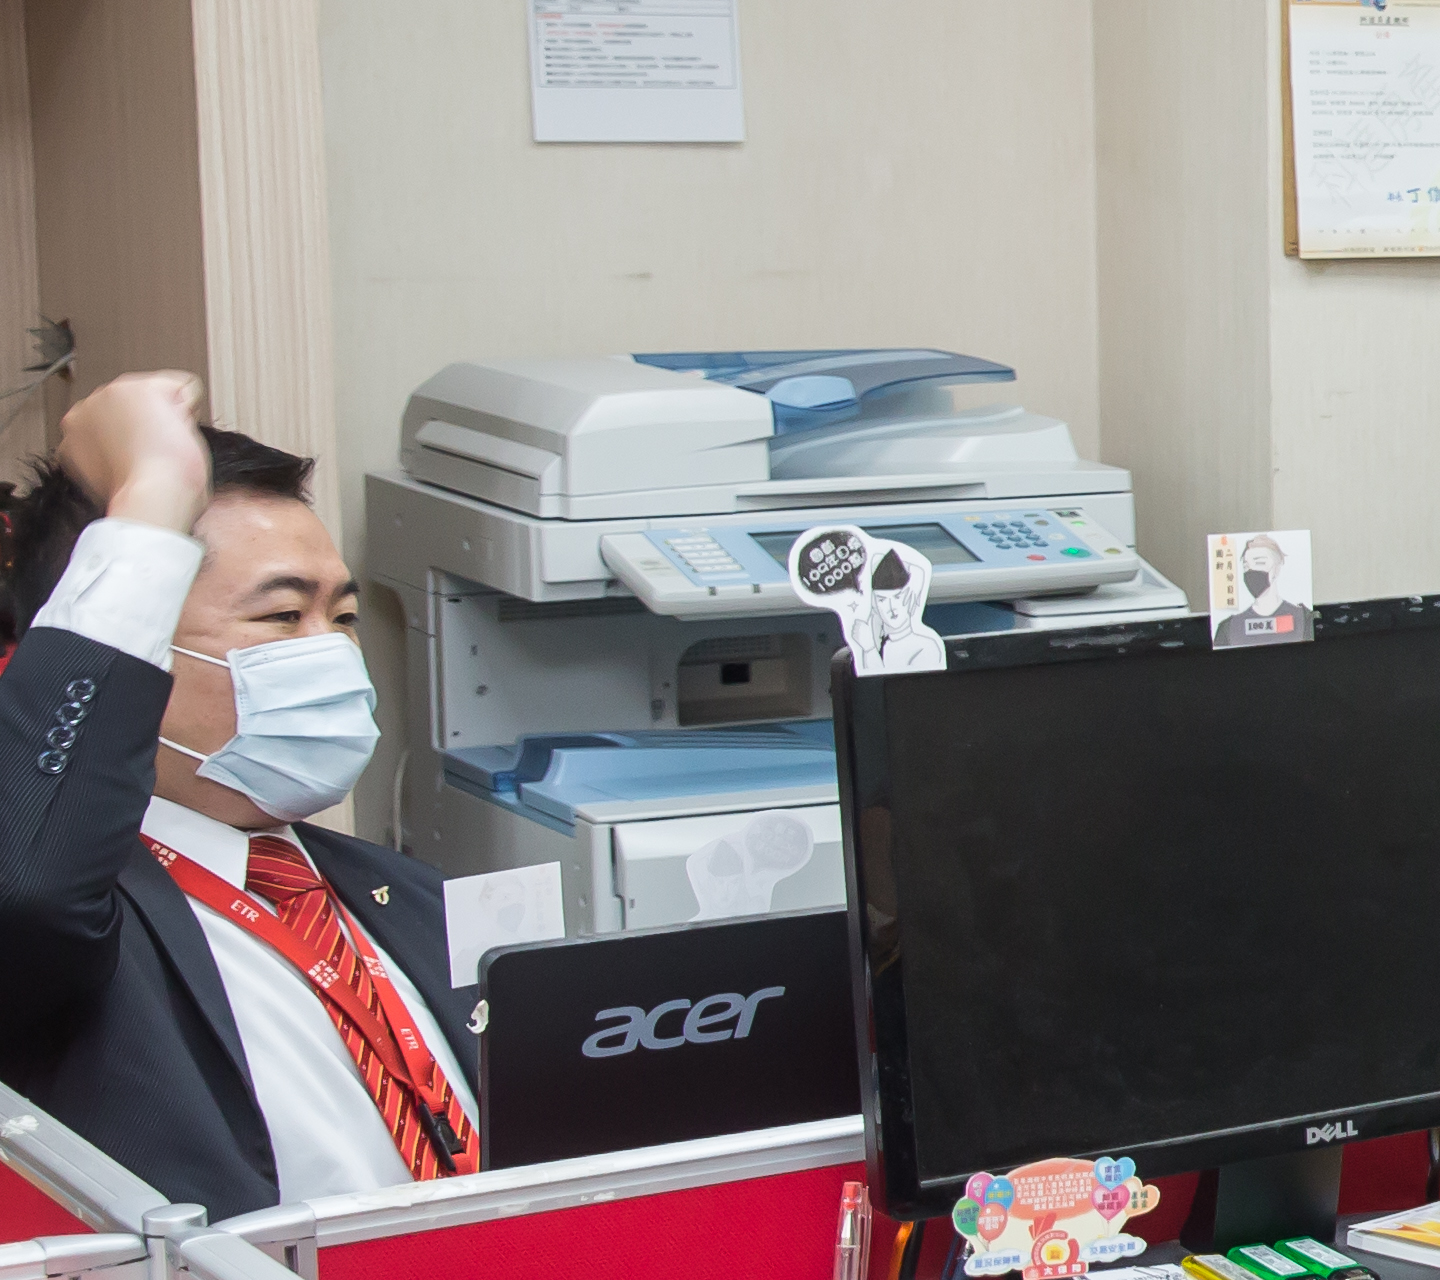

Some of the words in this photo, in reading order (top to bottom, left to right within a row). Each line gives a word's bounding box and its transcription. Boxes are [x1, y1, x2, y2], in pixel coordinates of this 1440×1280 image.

[229, 899, 260, 923] ETR
[581, 985, 786, 1059] acer
[400, 1028, 419, 1051] ETR
[1306, 1120, 1359, 1145] DELL
